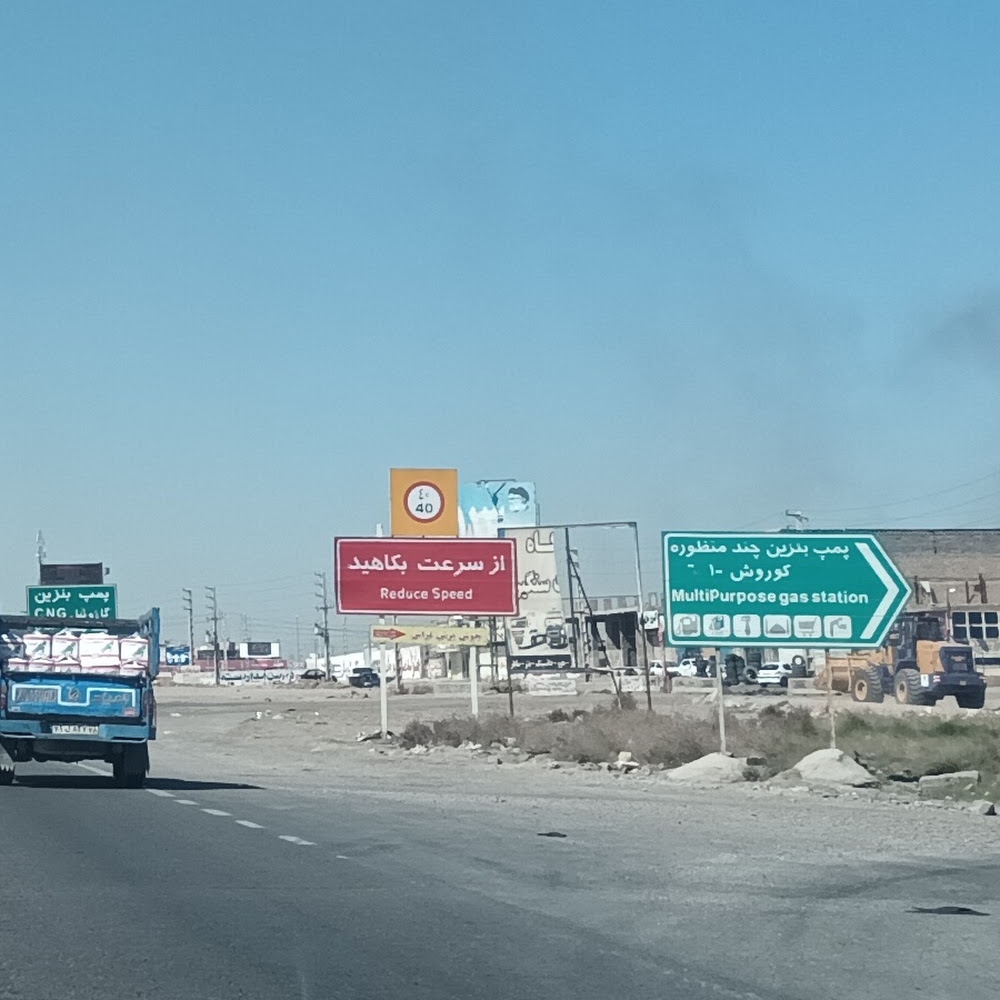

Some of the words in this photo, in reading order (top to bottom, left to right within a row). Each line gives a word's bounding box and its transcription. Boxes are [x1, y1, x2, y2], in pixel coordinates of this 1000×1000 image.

[415, 503, 433, 513] 40
[670, 540, 727, 558] منظوره
[732, 541, 761, 559] چند
[766, 543, 809, 558] بنزین
[813, 545, 849, 560] پمپ
[347, 554, 408, 575] بکاهید
[417, 557, 485, 577] سرعت
[488, 555, 506, 575] از
[730, 564, 791, 582] کوروش
[34, 589, 71, 604] بنزین
[79, 591, 110, 603] پمپ
[380, 587, 429, 600] Reduce
[432, 587, 473, 602] Speed
[671, 588, 777, 606] MultiPurpose
[779, 592, 809, 606] gas
[811, 590, 869, 605] station
[34, 607, 67, 618] CNG
